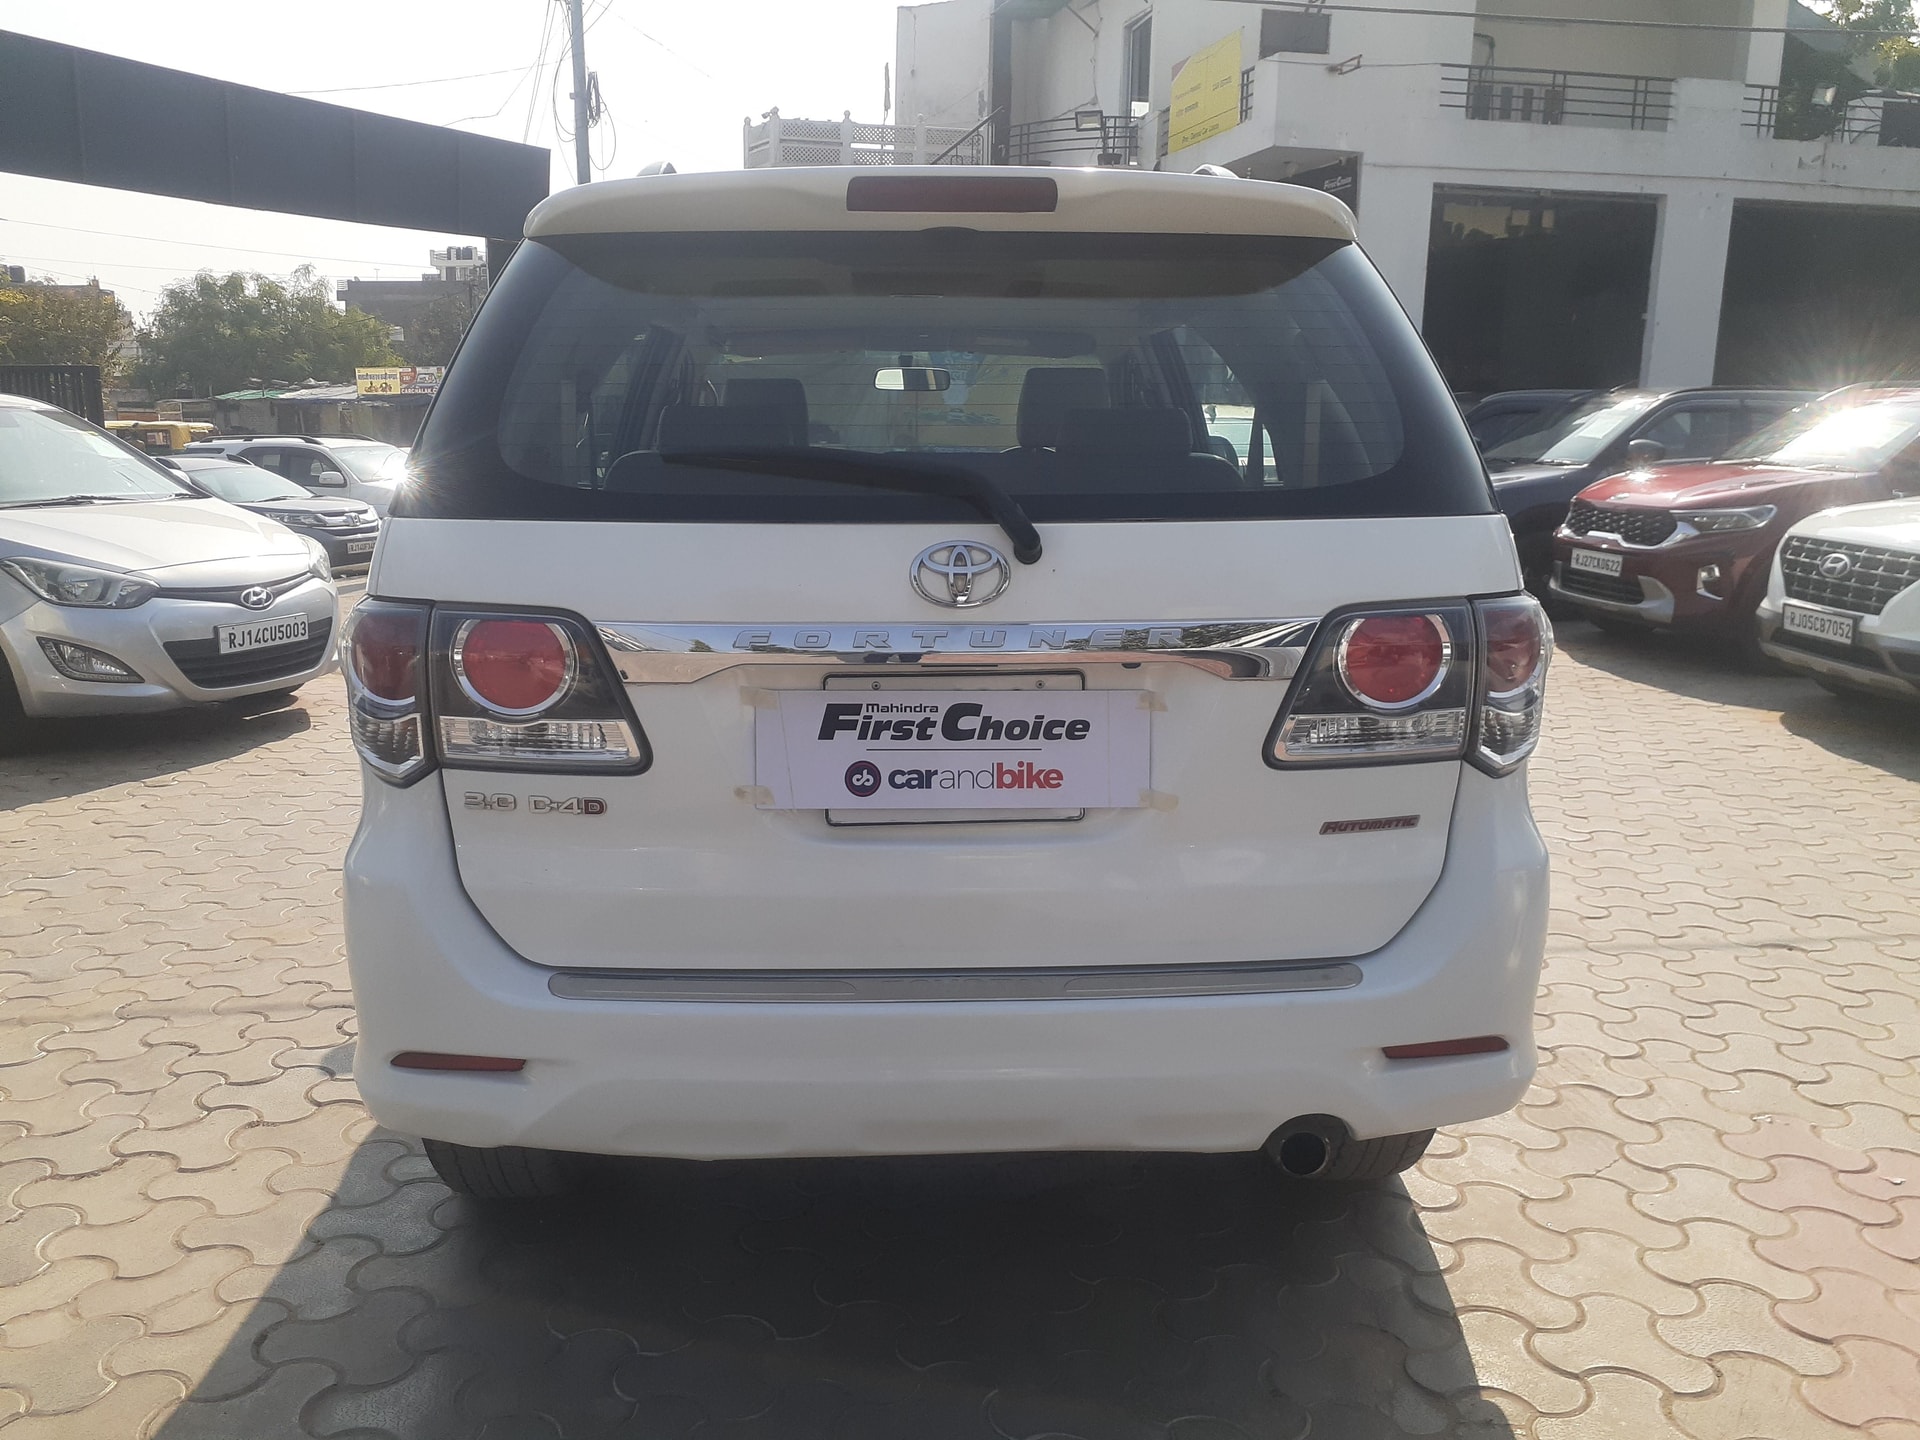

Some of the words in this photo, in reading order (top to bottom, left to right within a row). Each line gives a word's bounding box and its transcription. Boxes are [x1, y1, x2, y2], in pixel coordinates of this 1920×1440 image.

[228, 620, 307, 649] RJ14CU5003
[732, 627, 1186, 649] FORTUNER
[1789, 611, 1851, 639] RJ05CB7052
[865, 703, 939, 714] Mahindra
[817, 702, 938, 741] First
[941, 702, 1091, 742] Choice
[887, 760, 1064, 790] carandbike
[463, 791, 517, 811] 3.0
[527, 794, 608, 816] D-4D
[1320, 816, 1420, 834] AUTOMATIC
